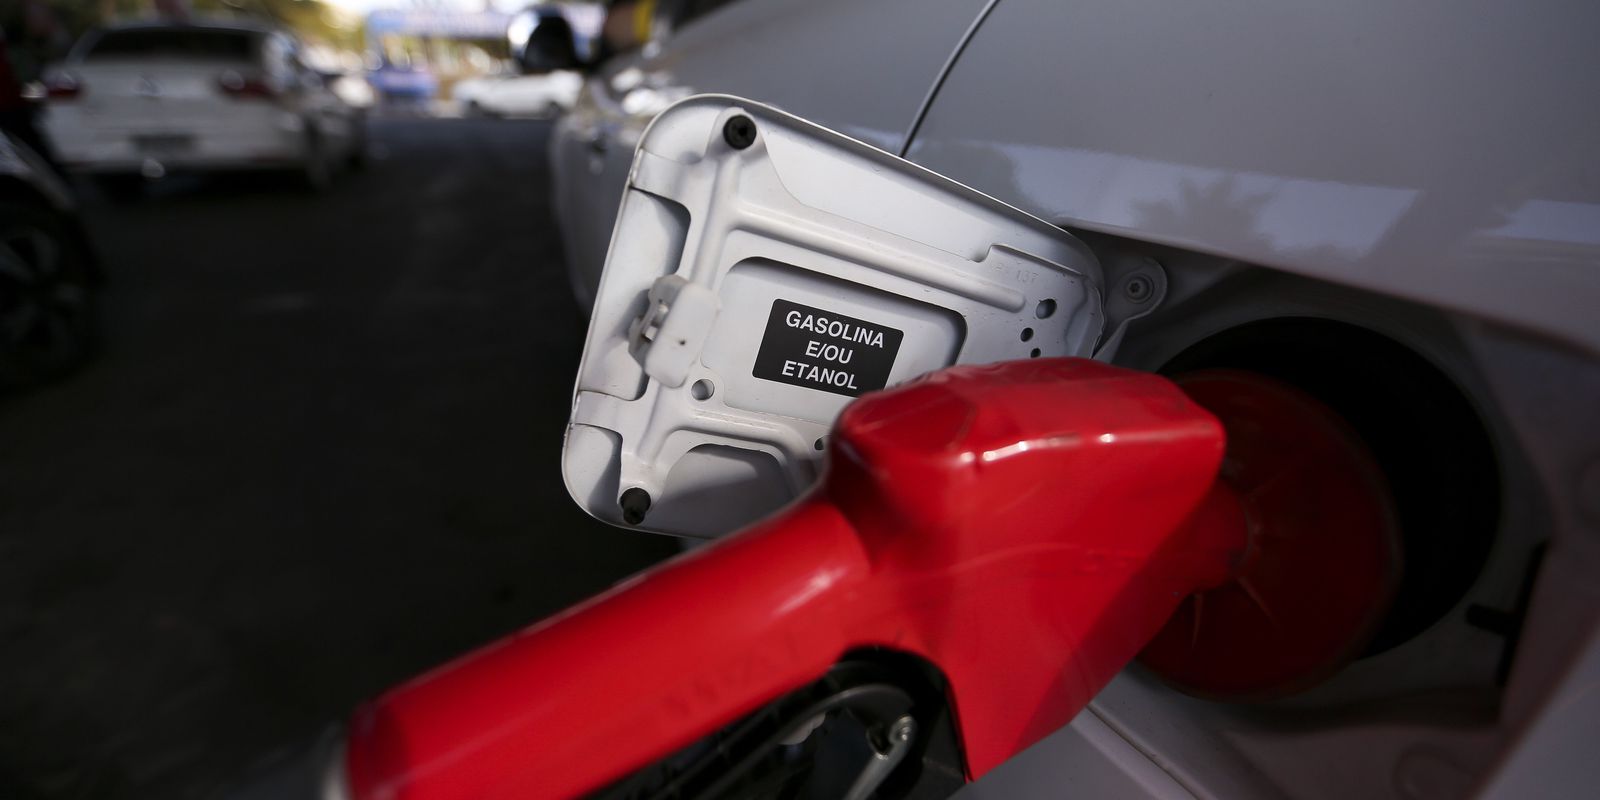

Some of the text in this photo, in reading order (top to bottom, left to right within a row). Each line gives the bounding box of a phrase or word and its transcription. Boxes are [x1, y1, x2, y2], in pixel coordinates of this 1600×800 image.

[786, 311, 884, 349] GASOLINA
[805, 340, 854, 364] E/OU
[782, 359, 858, 390] ETANOL
